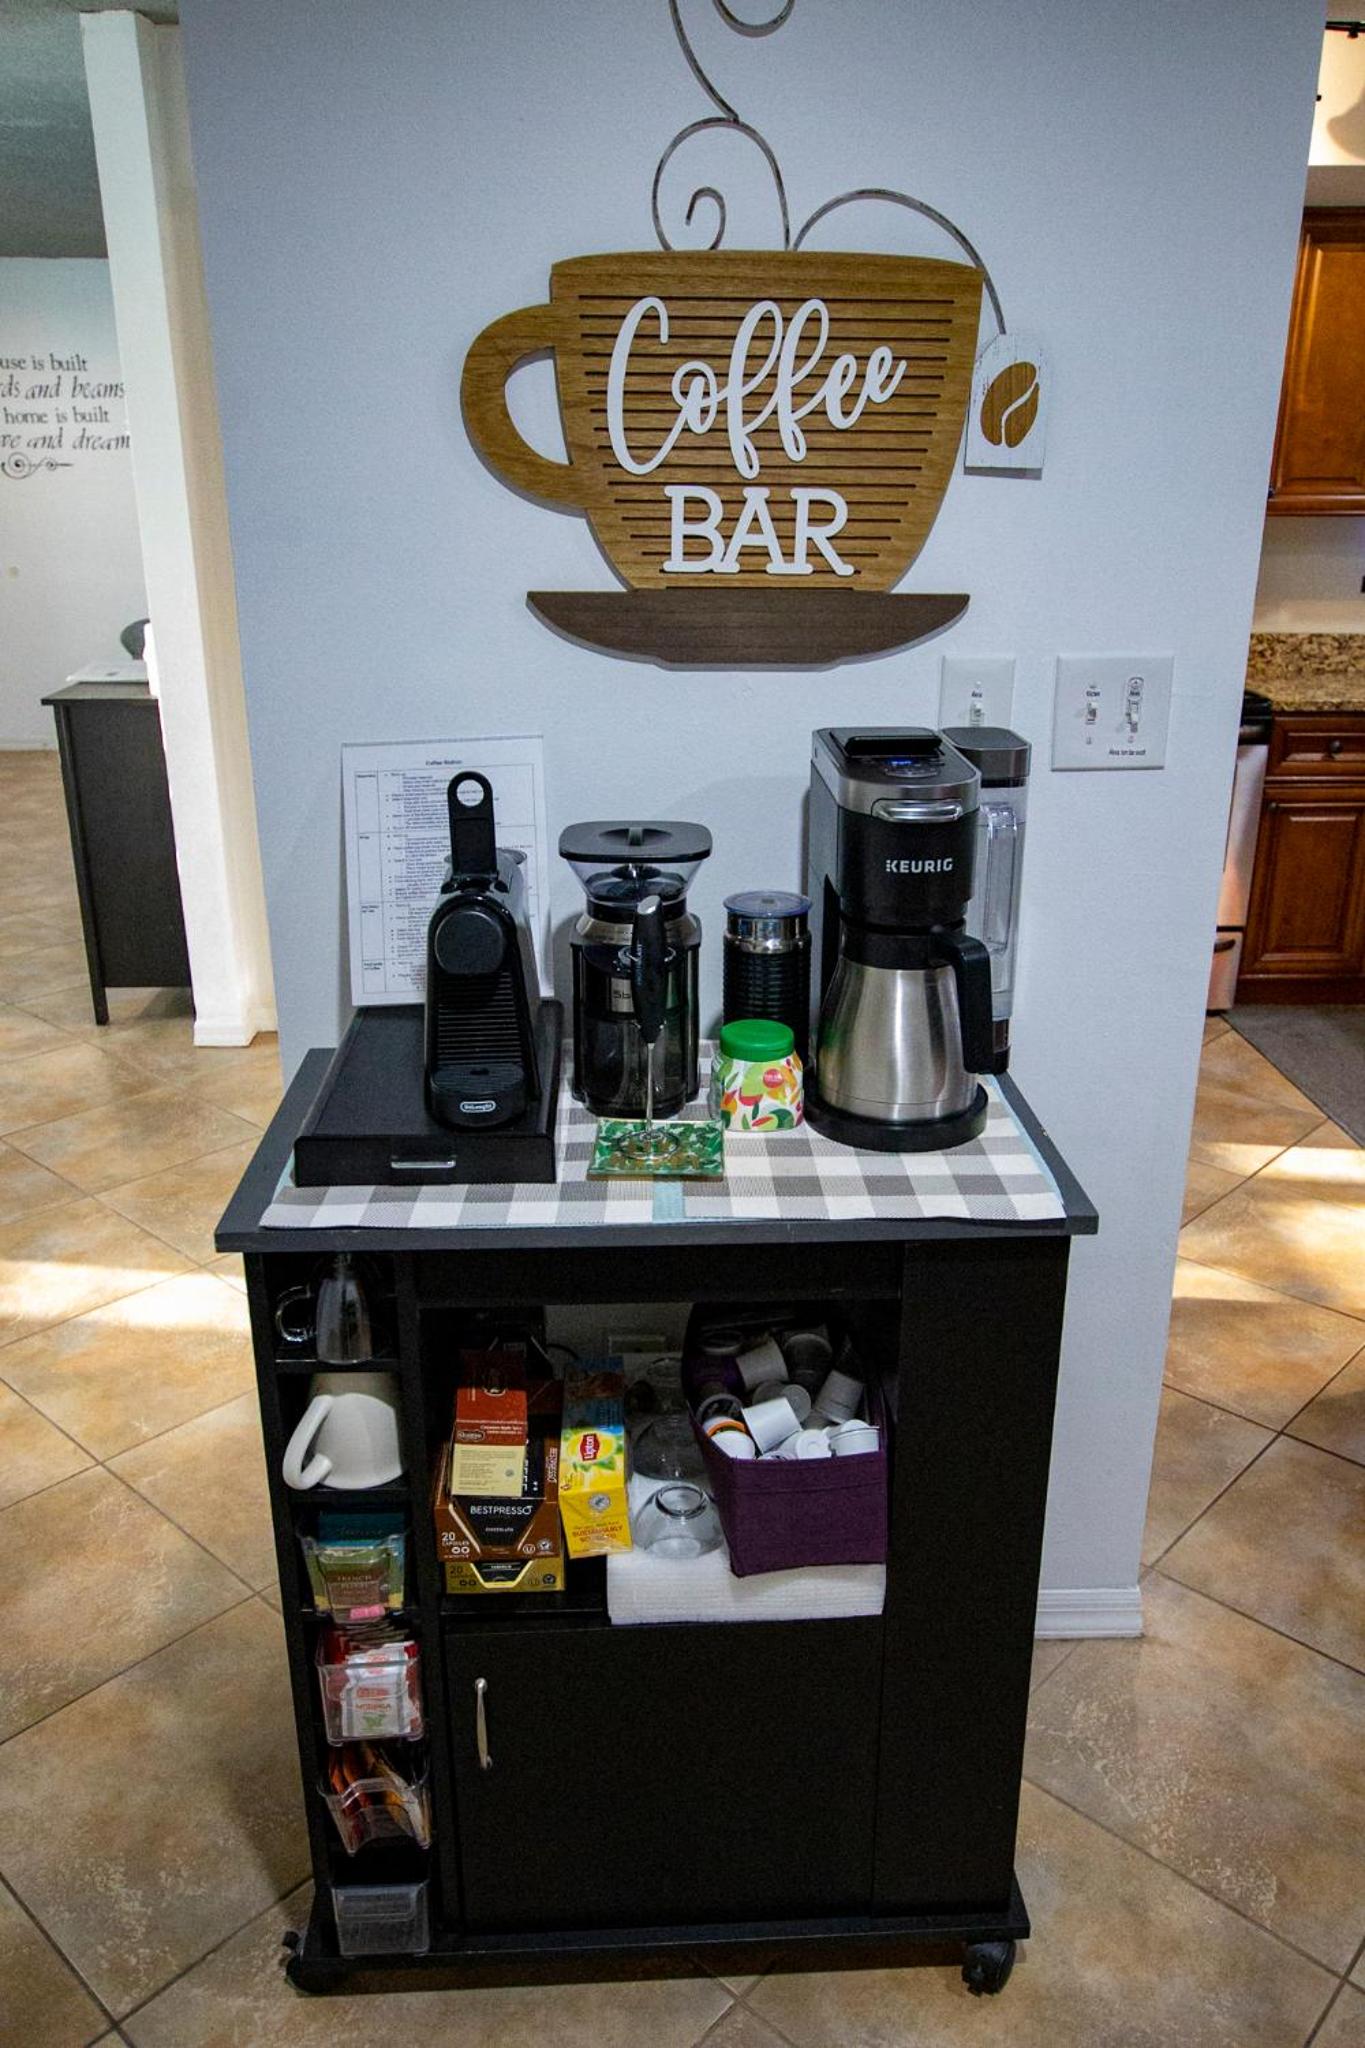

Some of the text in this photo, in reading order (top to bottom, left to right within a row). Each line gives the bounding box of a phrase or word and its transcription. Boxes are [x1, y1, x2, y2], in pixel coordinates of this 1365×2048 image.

[31, 355, 45, 371] is
[49, 353, 88, 372] built
[25, 375, 61, 400] and
[71, 376, 125, 399] beams
[606, 296, 908, 480] Coffee
[3, 406, 110, 424] home is built
[26, 426, 63, 449] and
[662, 484, 856, 577] BAR
[885, 858, 953, 873] KEURIG
[583, 1435, 596, 1459] Lipton
[470, 1505, 533, 1515] BESTPRESSO
[441, 1532, 456, 1541] 20
